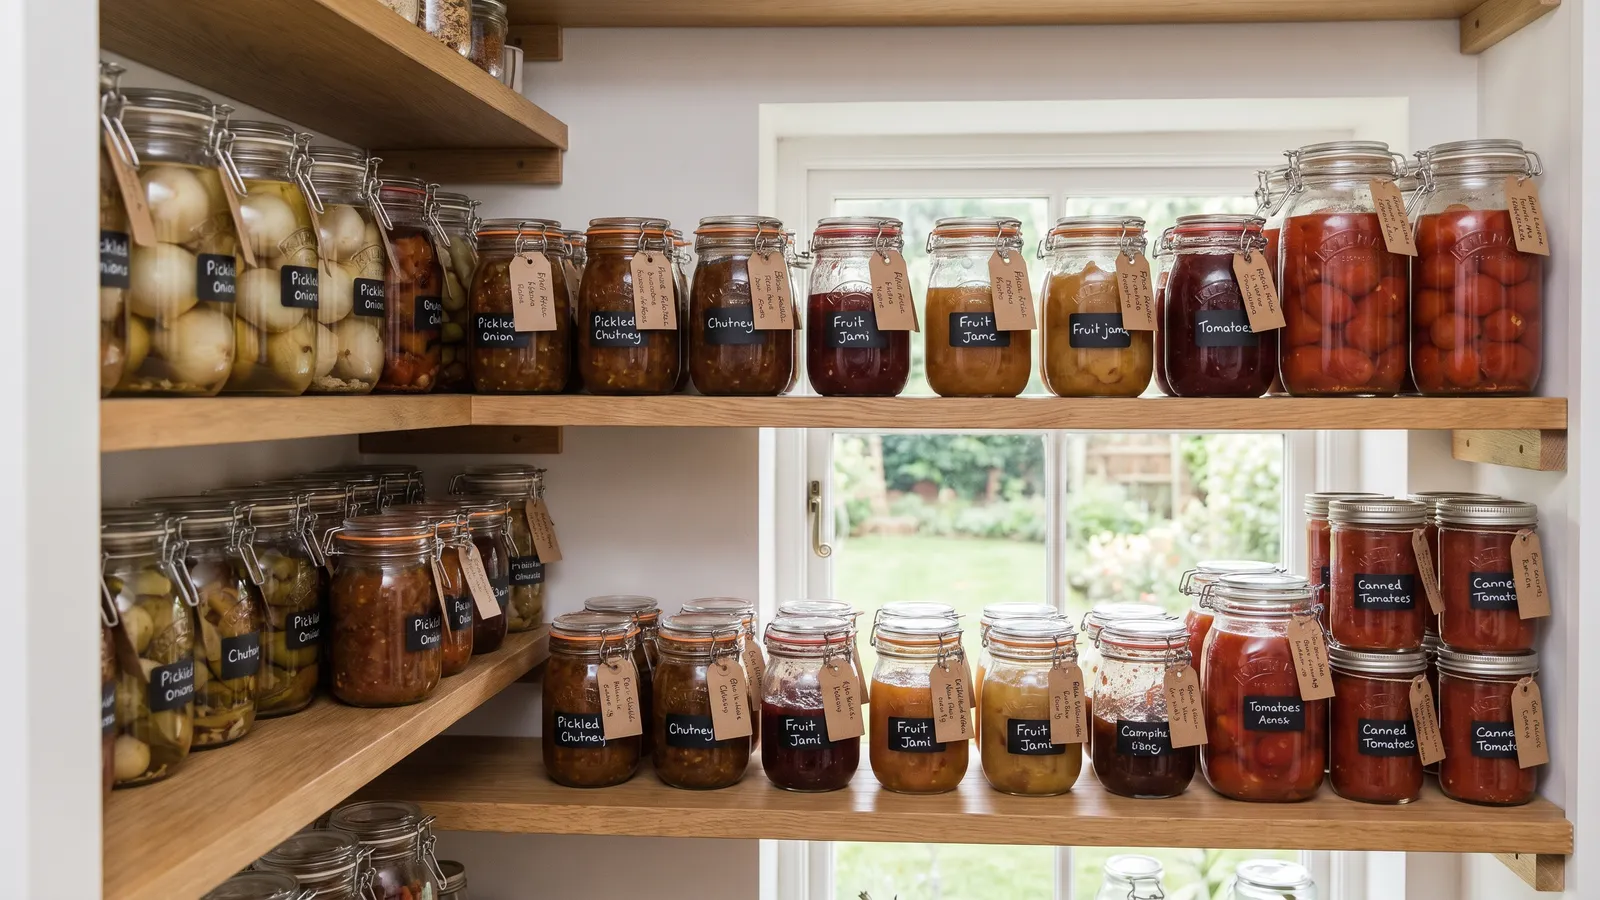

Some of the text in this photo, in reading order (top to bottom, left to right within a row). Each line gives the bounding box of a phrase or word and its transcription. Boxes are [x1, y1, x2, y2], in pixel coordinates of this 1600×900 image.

[594, 314, 635, 329] Pickled
[833, 315, 865, 328] Fruit
[960, 315, 992, 328] Fruit
[1073, 322, 1100, 335] Fruit
[482, 331, 514, 341] Onion
[595, 329, 641, 345] Chutney
[1358, 579, 1402, 591] Canned
[1473, 591, 1518, 602] Tomato
[1249, 701, 1301, 713] Tomatoes
[557, 715, 600, 730] Pickled
[785, 718, 817, 732] Fruit
[897, 721, 929, 734] Fruit
[669, 722, 714, 741] Chutney
[1016, 723, 1049, 737] Fruit
[1362, 723, 1408, 736] Canned
[1476, 726, 1516, 738] Canne
[561, 730, 606, 747] Chutney
[789, 733, 822, 747] Jami
[900, 735, 932, 748] Jami
[1363, 738, 1416, 750] Tomatoes
[1476, 740, 1518, 752] Tomato
